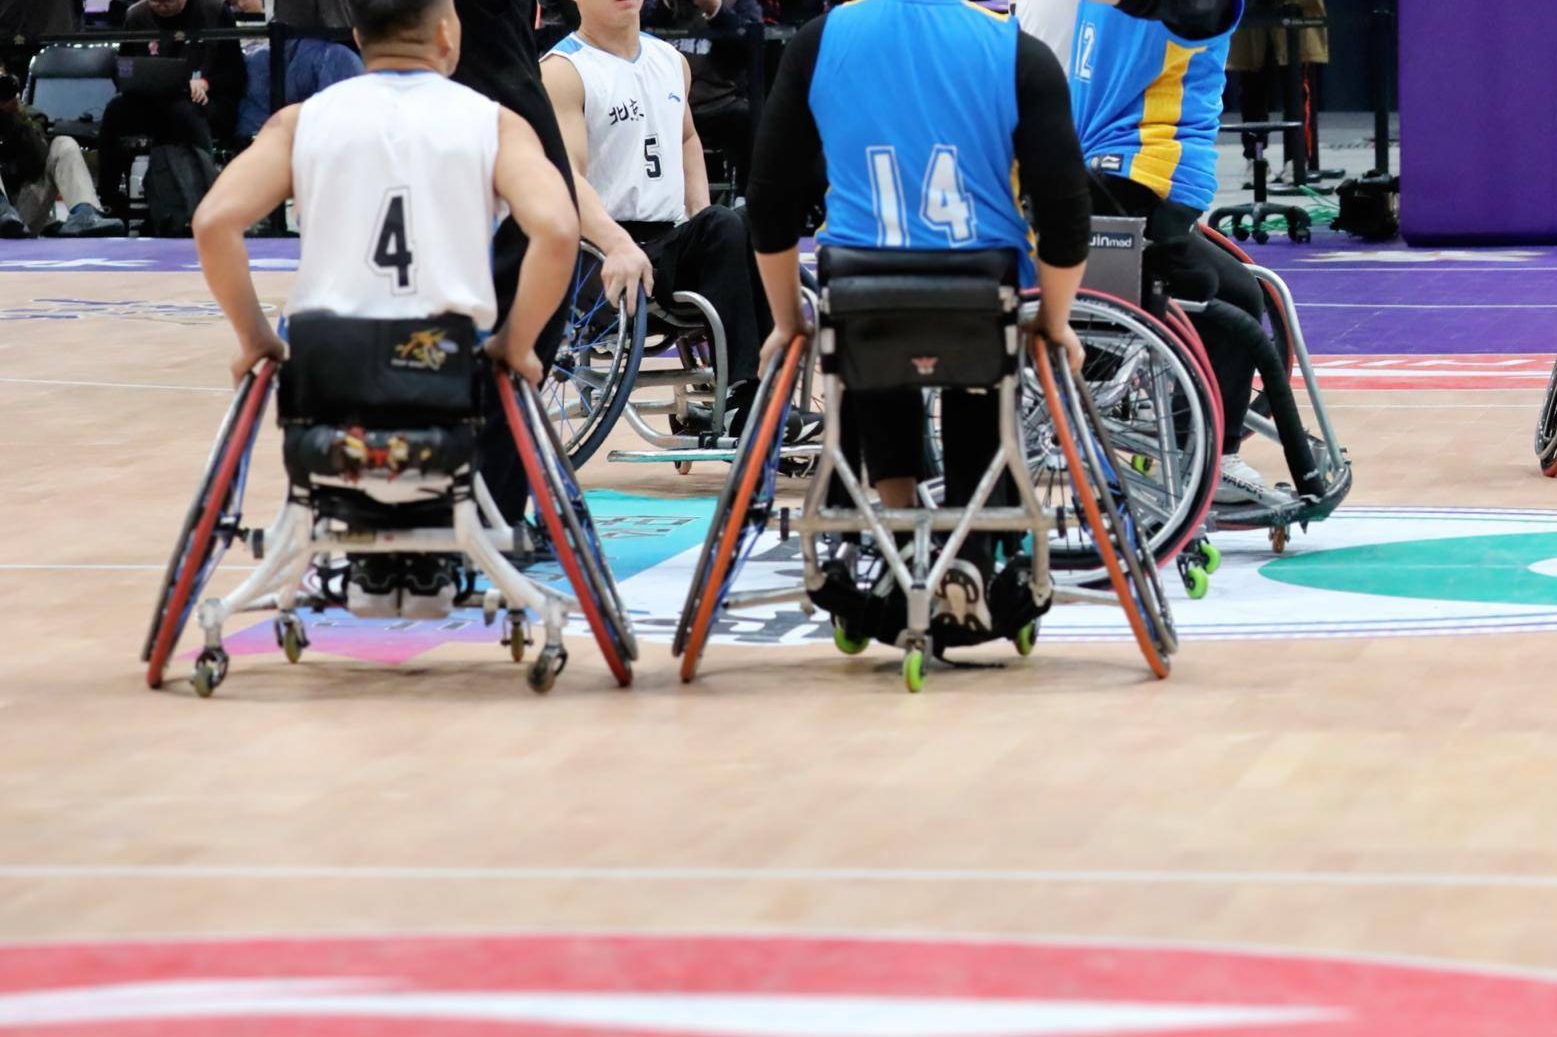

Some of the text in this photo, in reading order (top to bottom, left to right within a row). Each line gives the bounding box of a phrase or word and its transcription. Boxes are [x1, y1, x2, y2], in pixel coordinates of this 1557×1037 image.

[608, 98, 645, 126] 北京
[643, 135, 663, 180] 5
[866, 145, 977, 248] 14
[367, 188, 416, 293] 4
